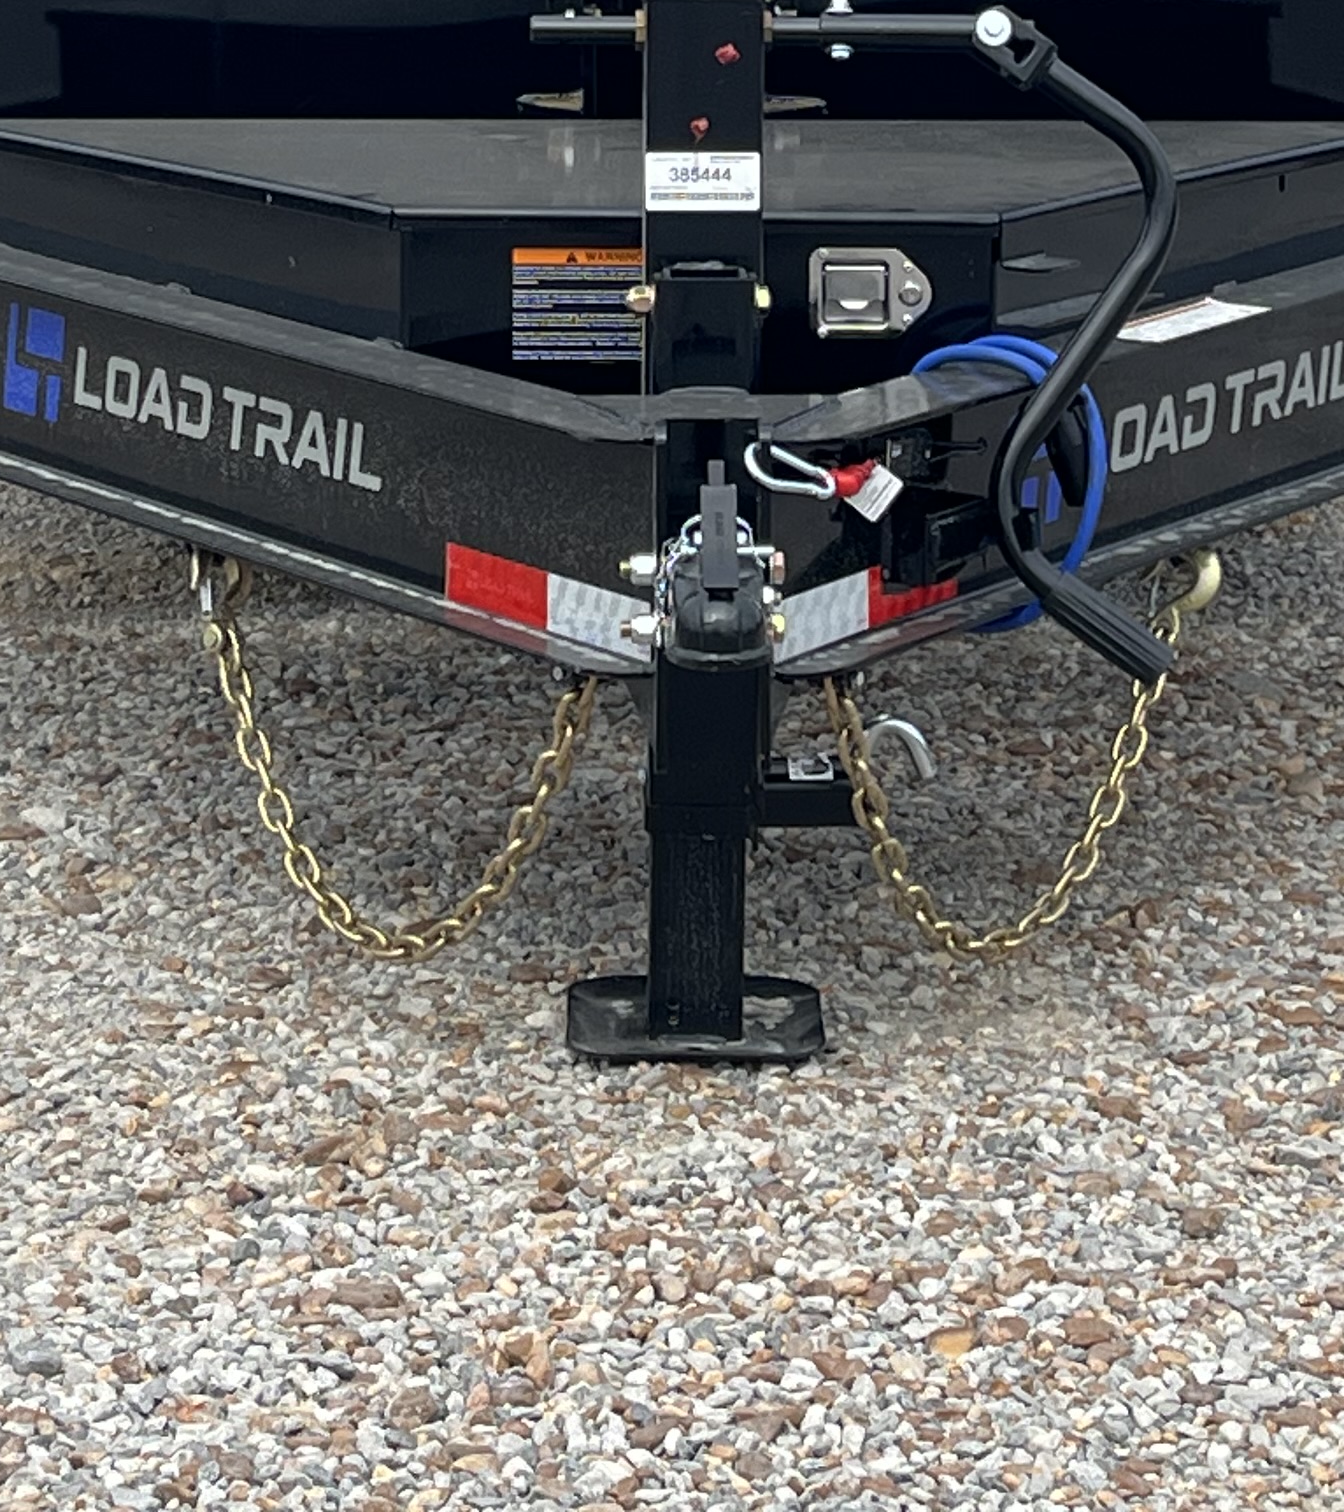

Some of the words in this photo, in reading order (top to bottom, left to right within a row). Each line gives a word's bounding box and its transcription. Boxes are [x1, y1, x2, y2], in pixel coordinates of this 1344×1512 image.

[669, 167, 732, 183] 385444
[74, 346, 213, 440] LOAD
[223, 386, 382, 492] TRAIL
[1110, 382, 1217, 473] OAD
